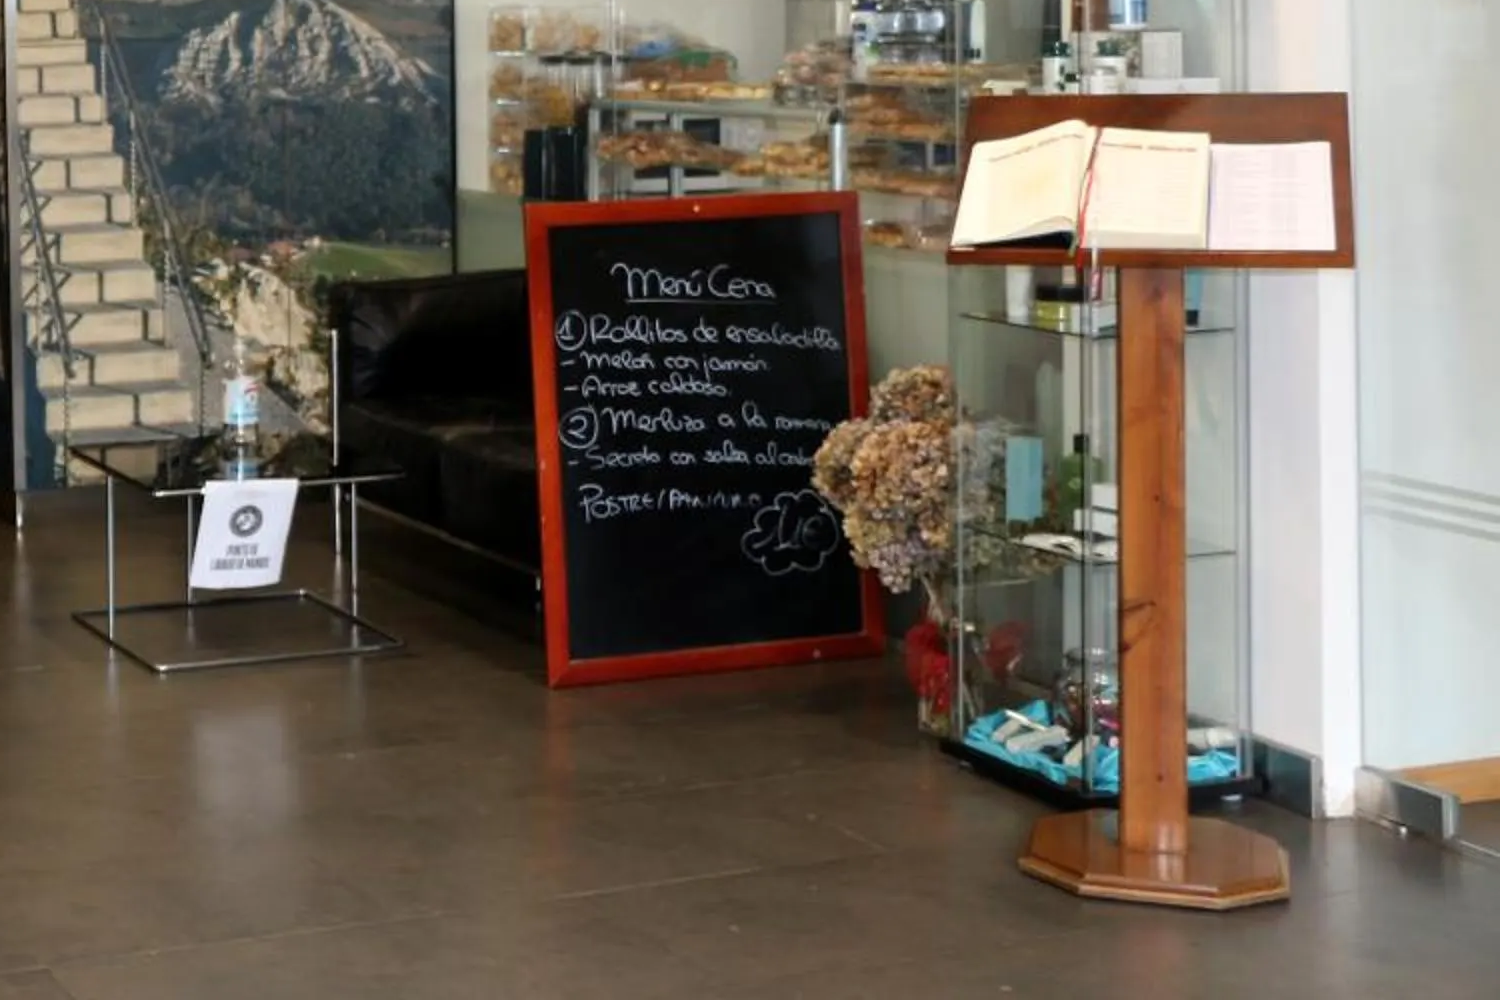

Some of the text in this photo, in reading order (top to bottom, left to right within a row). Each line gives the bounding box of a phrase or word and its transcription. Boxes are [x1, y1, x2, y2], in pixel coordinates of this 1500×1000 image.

[707, 264, 777, 298] Cena
[589, 313, 688, 345] Rollitos
[692, 317, 720, 343] de
[663, 354, 699, 371] con
[601, 407, 706, 435] Merluza
[717, 413, 736, 428] a
[741, 400, 768, 430] la
[669, 451, 698, 466] con
